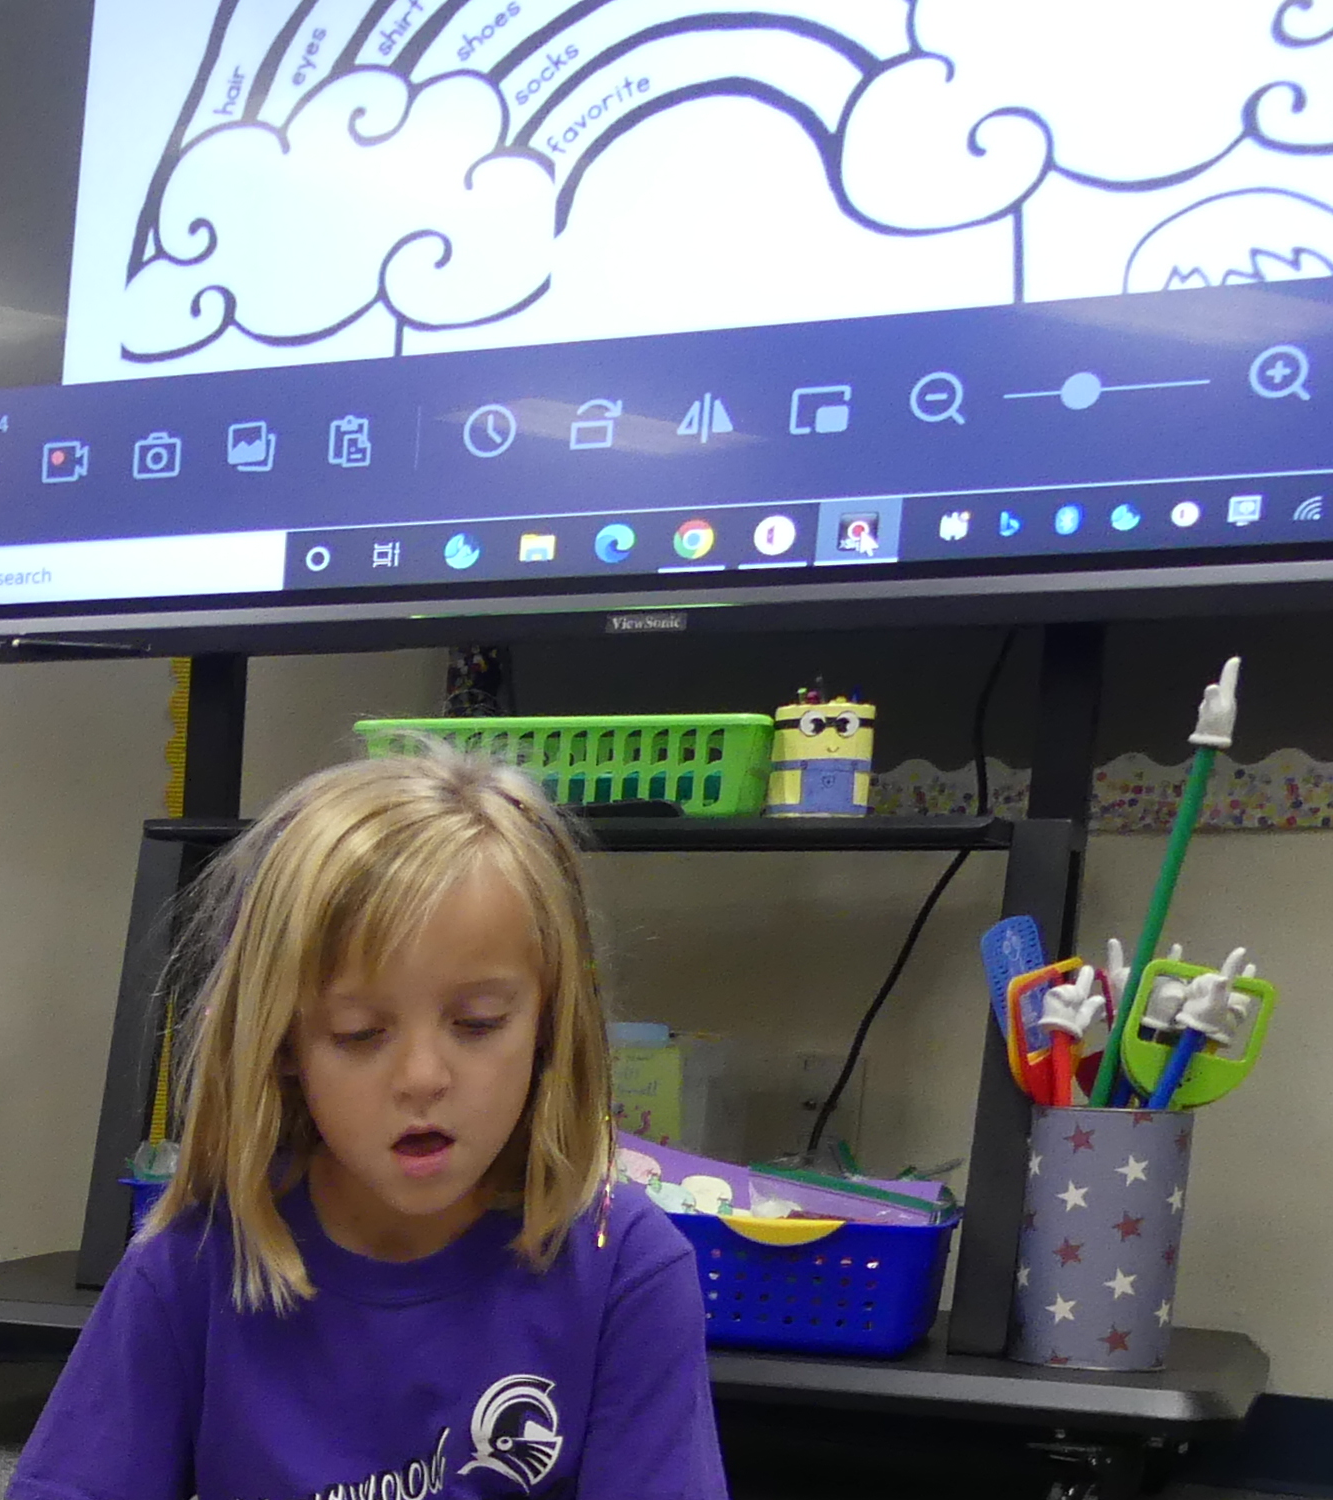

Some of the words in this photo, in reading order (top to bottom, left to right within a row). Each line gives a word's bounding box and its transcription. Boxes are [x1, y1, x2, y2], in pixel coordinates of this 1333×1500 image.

[291, 26, 328, 87] eyes
[378, 0, 426, 57] shirt
[456, 1, 522, 62] shoes
[213, 65, 246, 116] hair
[515, 42, 580, 106] socks
[546, 74, 652, 155] favorite
[612, 616, 680, 630] ViewSonic
